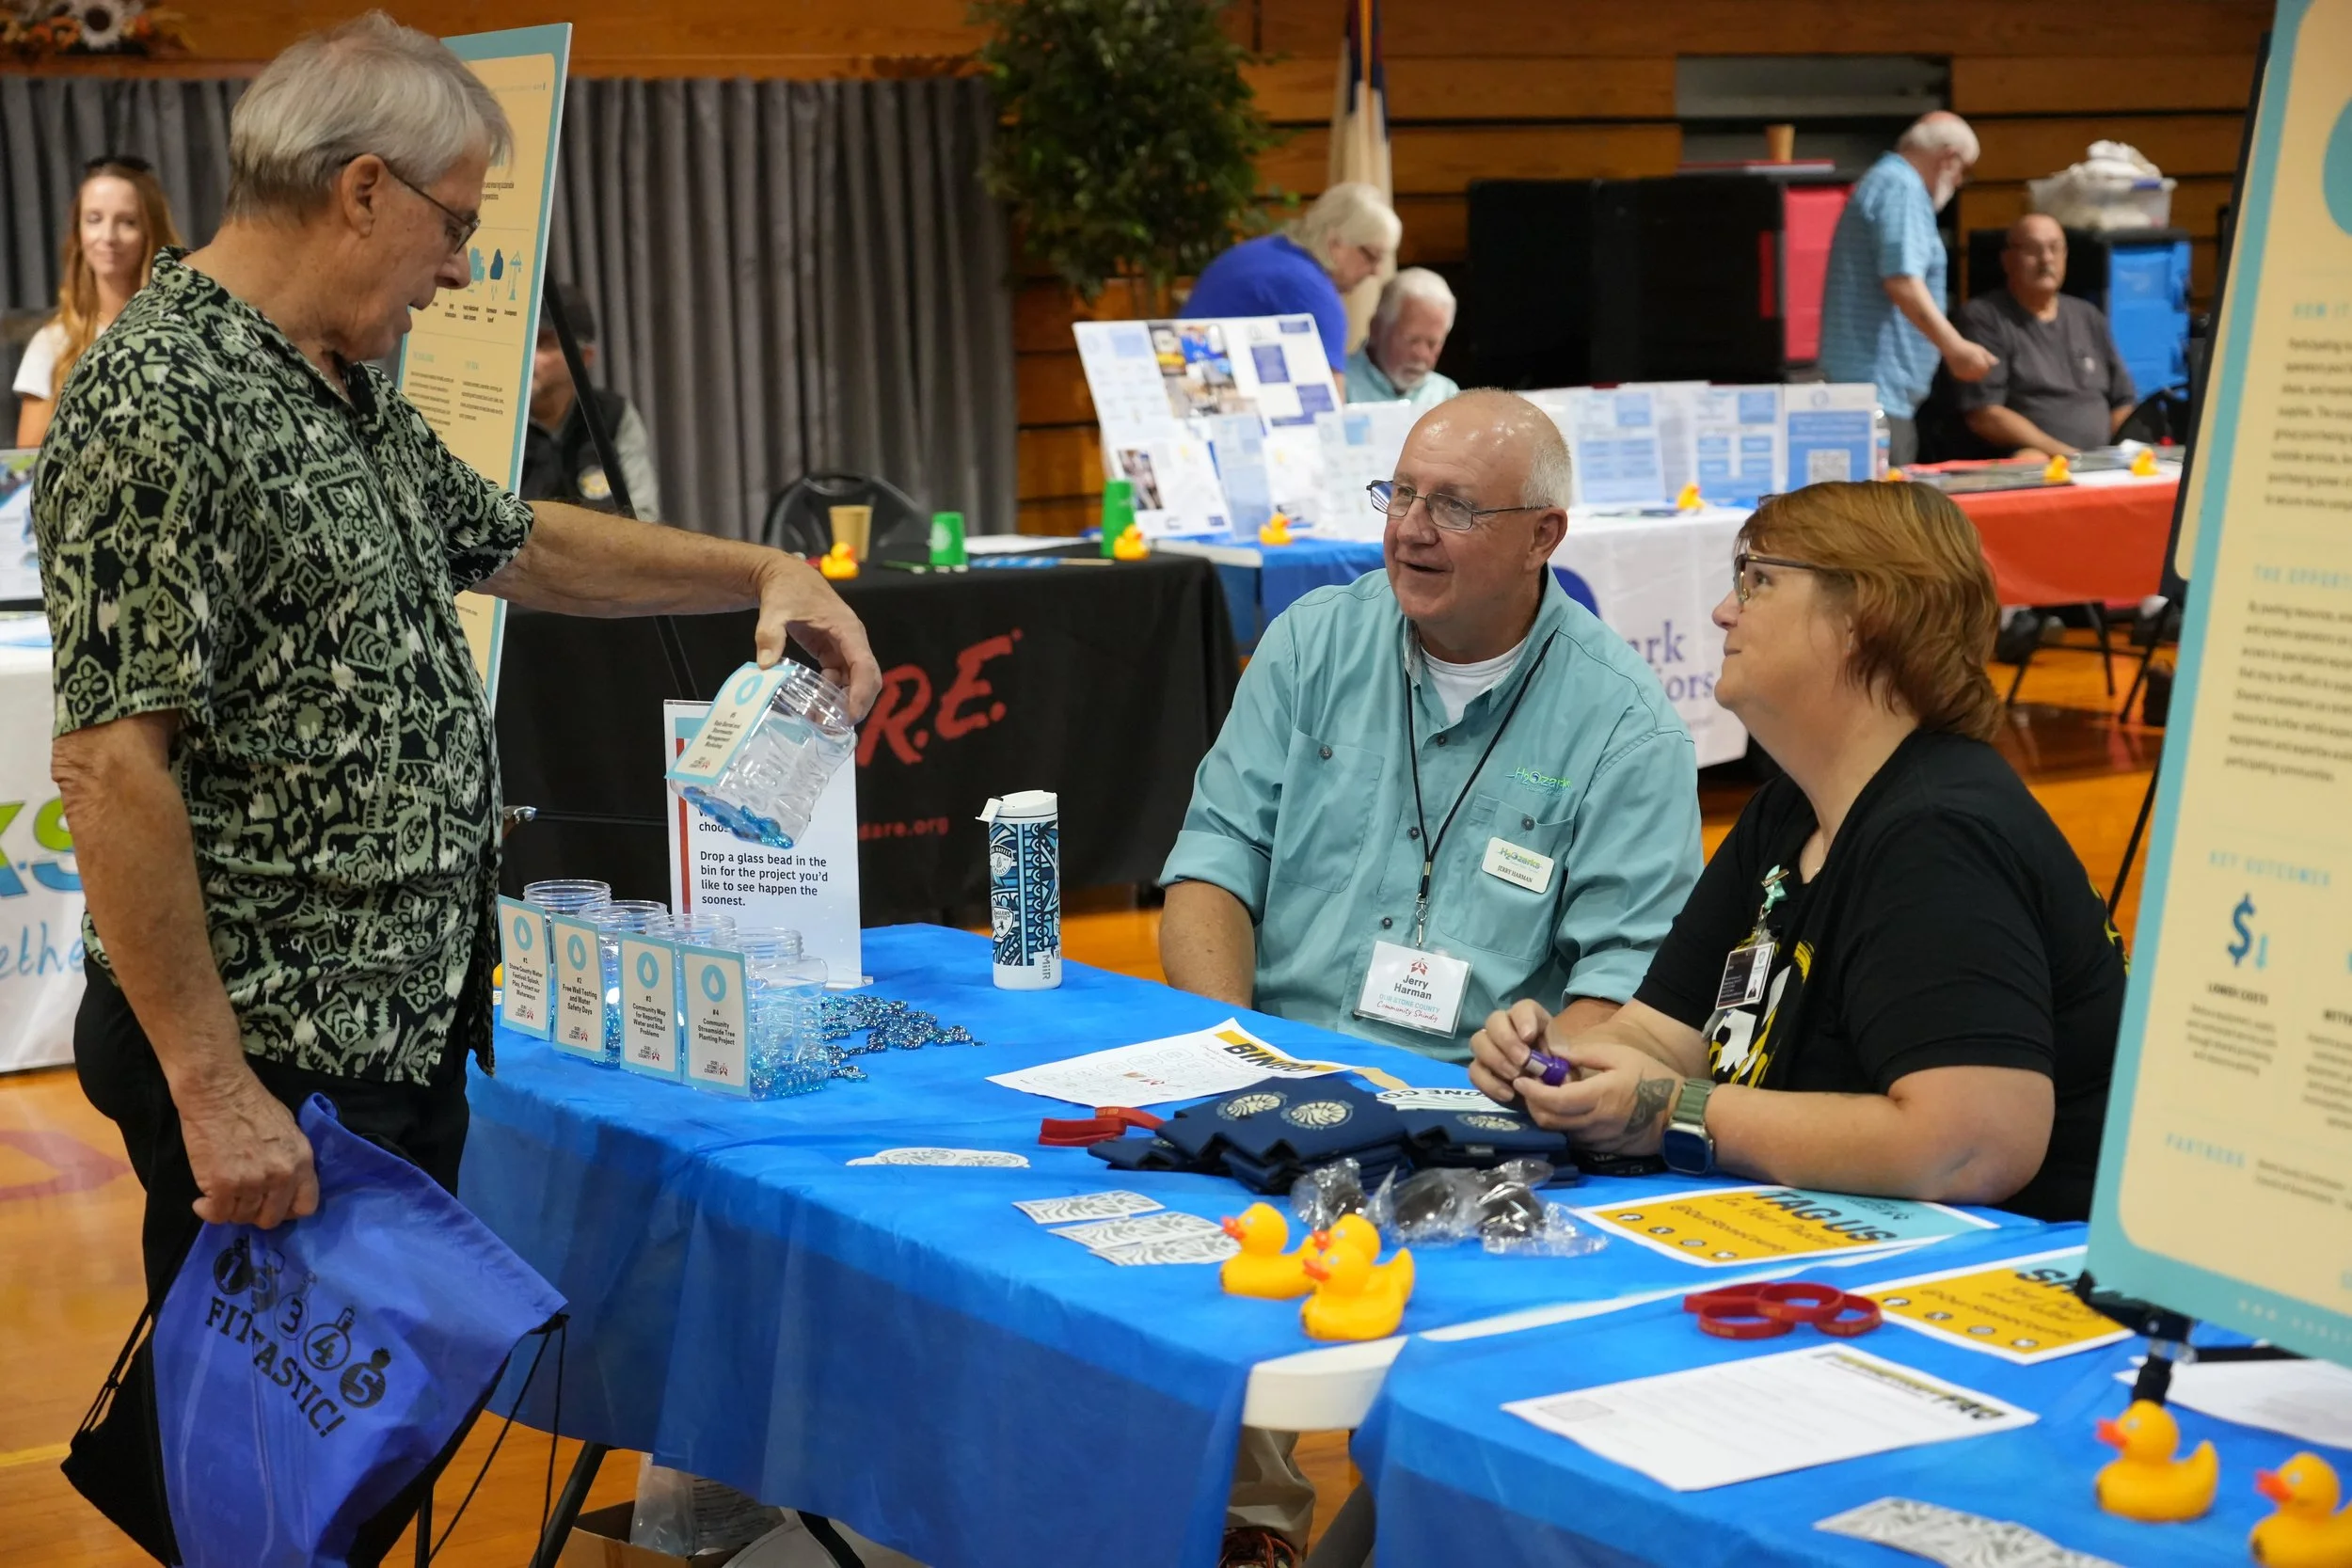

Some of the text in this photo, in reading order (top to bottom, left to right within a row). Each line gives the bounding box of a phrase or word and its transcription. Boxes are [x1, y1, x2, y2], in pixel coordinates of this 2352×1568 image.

[700, 851, 827, 867] Drop a glass bead in the
[701, 865, 717, 876] bin
[720, 865, 735, 877] for
[739, 867, 755, 878] the
[759, 868, 796, 881] project
[1498, 864, 1513, 876] JERRY
[1512, 869, 1534, 882] HARMAN
[701, 879, 818, 895] like to see happen the
[702, 895, 746, 906] soonest.
[1042, 955, 1051, 979] MiiR
[1403, 974, 1429, 990] Jerry
[563, 984, 597, 1000] Free Well Testing
[1393, 982, 1432, 1000] Harman
[567, 1003, 593, 1015] Safety Days
[577, 997, 591, 1006] Water
[1393, 996, 1413, 1007] STONE
[1415, 1001, 1440, 1013] COUNTY
[633, 1003, 666, 1017] Community Map
[643, 1012, 662, 1024] Reporting
[1376, 1001, 1438, 1022] Community Shindig
[633, 1019, 646, 1027] Water
[698, 1024, 724, 1036] Streamside
[703, 1018, 729, 1029] Community
[640, 1027, 660, 1037] Problems
[698, 1033, 735, 1045] Planting Project
[1223, 1042, 1317, 1071] BINGO
[1754, 1191, 1843, 1222] TAG
[1820, 1219, 1898, 1242] US
